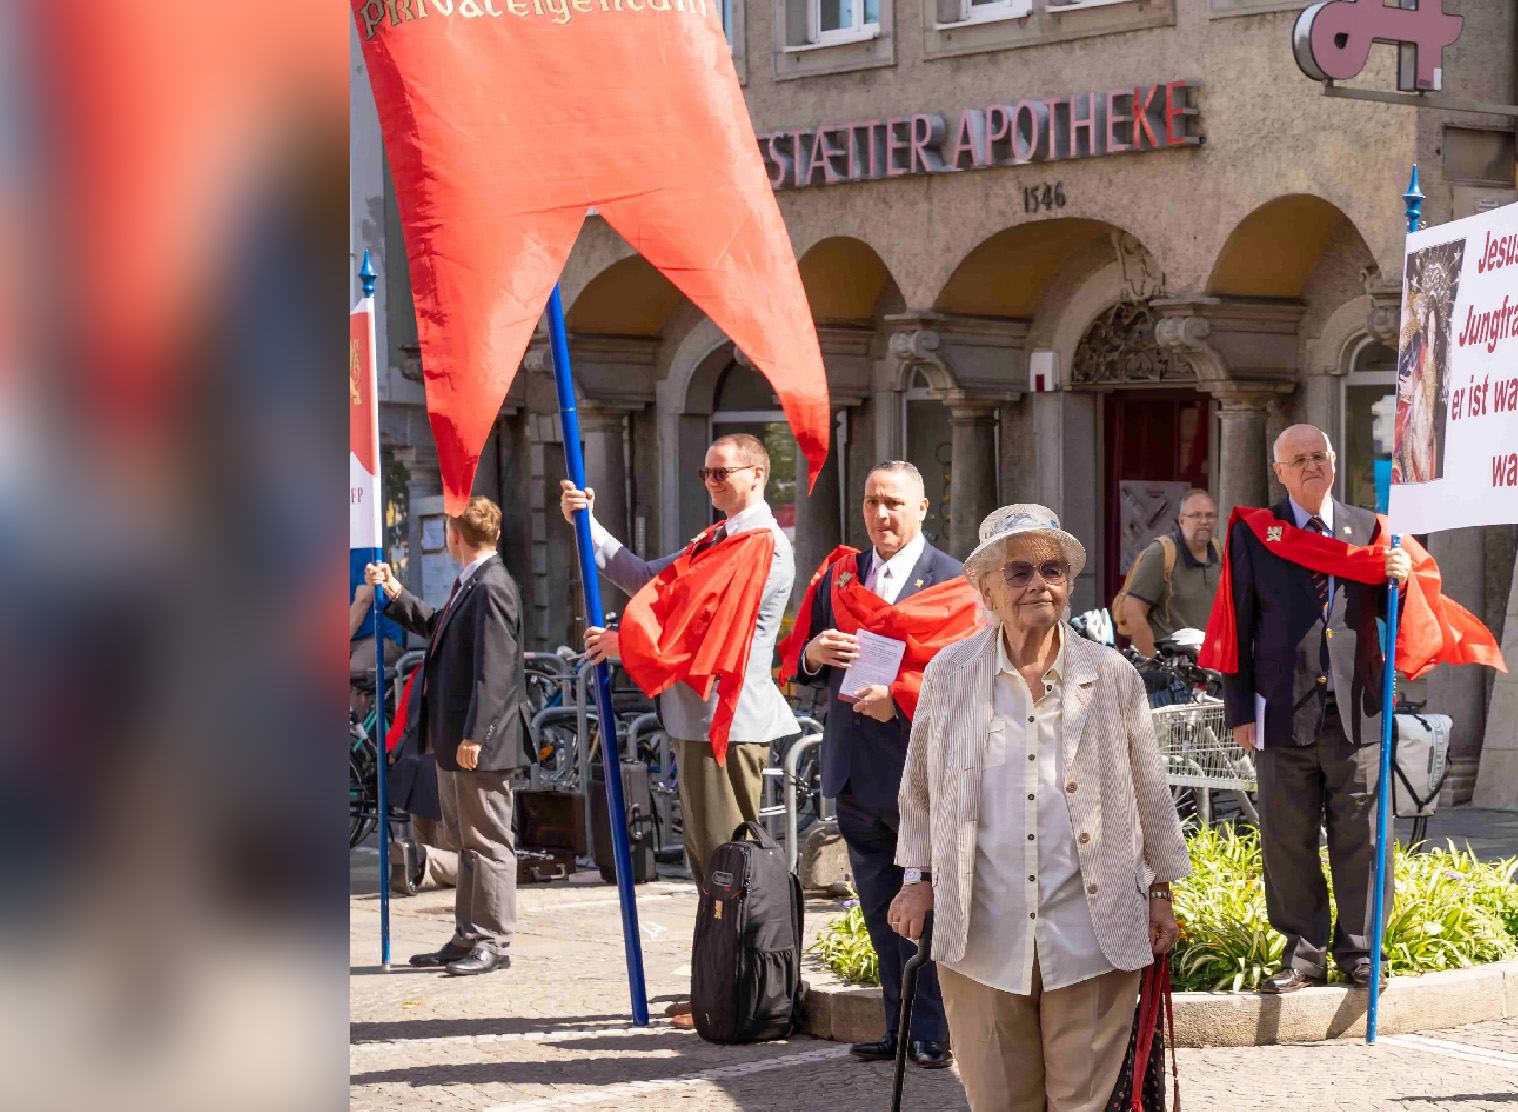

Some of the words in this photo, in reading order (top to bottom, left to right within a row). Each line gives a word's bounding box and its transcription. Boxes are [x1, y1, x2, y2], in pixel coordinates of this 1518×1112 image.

[763, 113, 934, 190] STÆTTER
[952, 80, 1188, 169] APOTHEKE
[1022, 182, 1067, 213] 1546
[1451, 388, 1466, 421] er
[1468, 373, 1489, 418] ist
